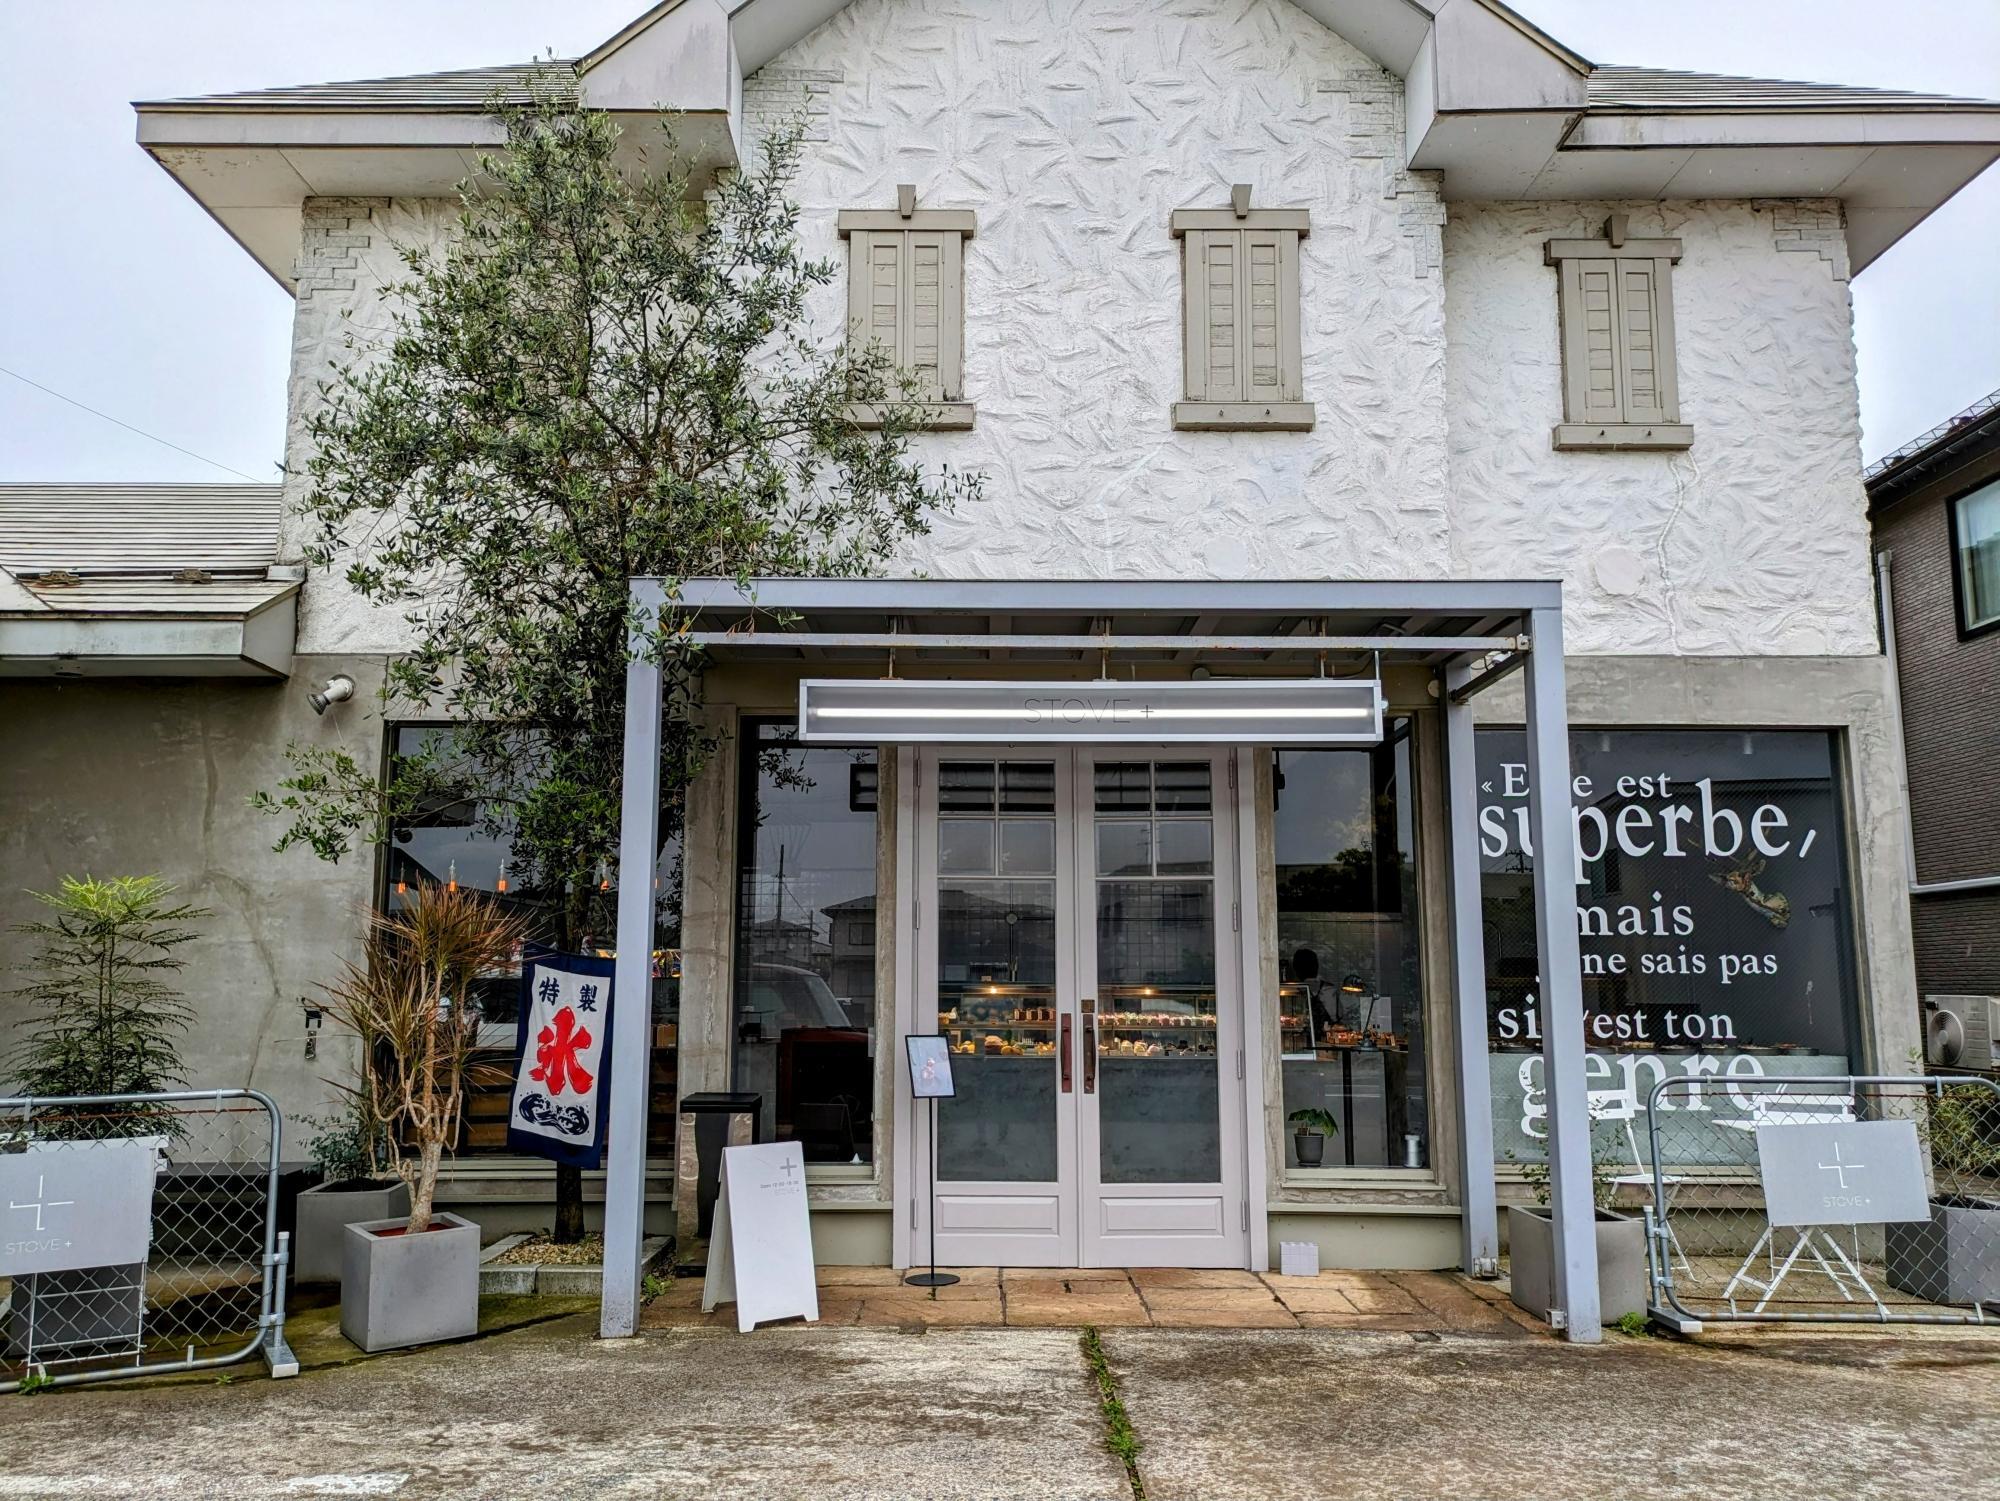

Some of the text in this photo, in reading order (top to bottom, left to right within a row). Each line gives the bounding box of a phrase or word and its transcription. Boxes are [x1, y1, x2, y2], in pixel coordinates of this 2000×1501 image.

[1500, 763, 1592, 798] Ee
[1617, 773, 1672, 798] est
[1577, 891, 1694, 936] mais
[1582, 944, 1778, 984] ne sais pas
[538, 976, 598, 1012] 特製
[1498, 993, 1542, 1039] si
[1664, 1009, 1737, 1039] ton
[528, 1006, 594, 1096] 氷
